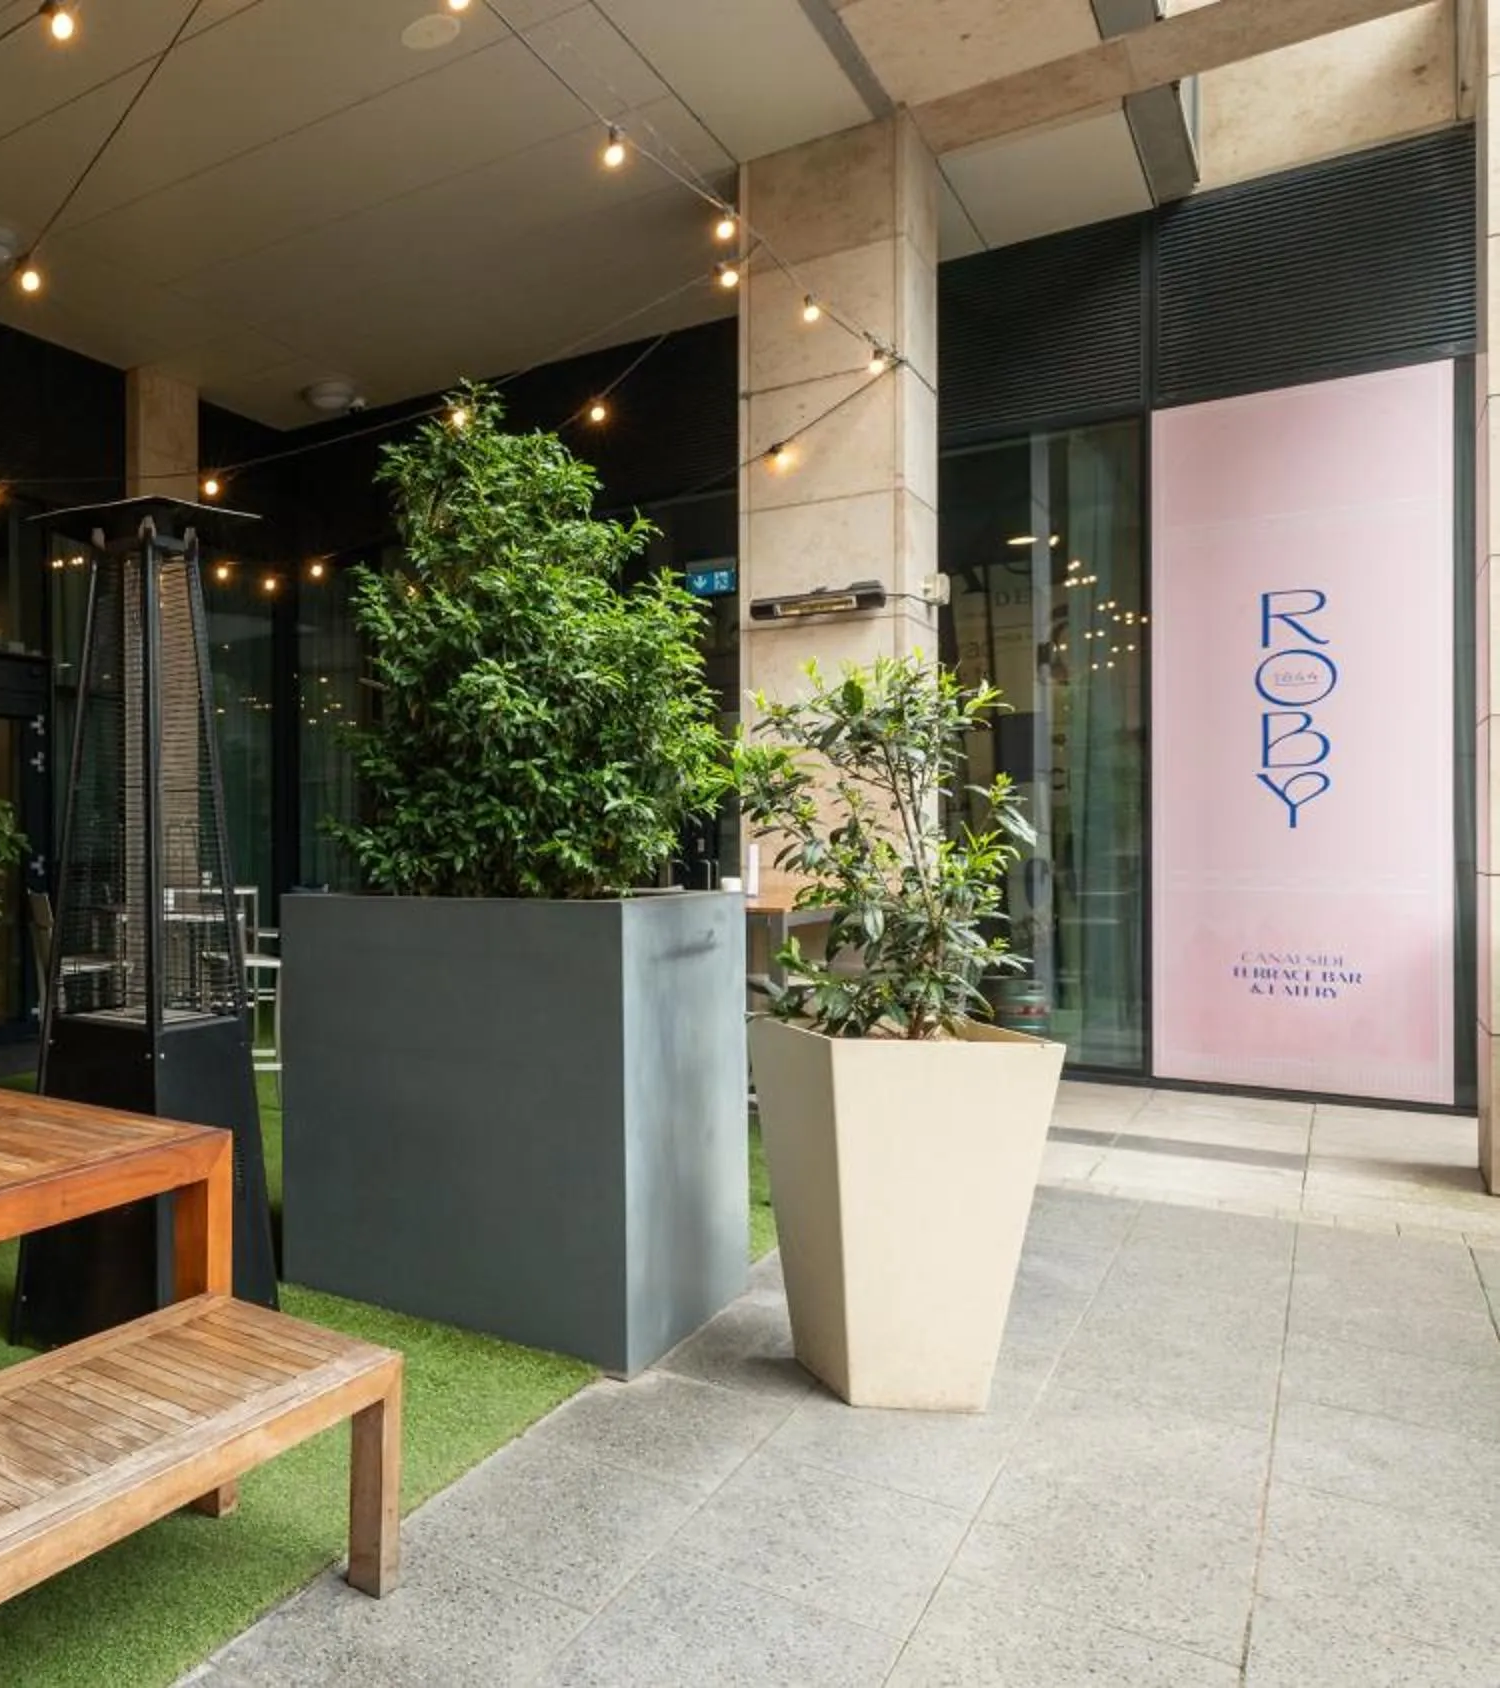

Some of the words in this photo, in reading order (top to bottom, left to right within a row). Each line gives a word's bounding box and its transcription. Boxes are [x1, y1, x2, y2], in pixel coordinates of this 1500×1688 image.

[1254, 588, 1338, 829] ROBY
[1232, 965, 1312, 982] TERRACE
[1321, 970, 1363, 985] BAR
